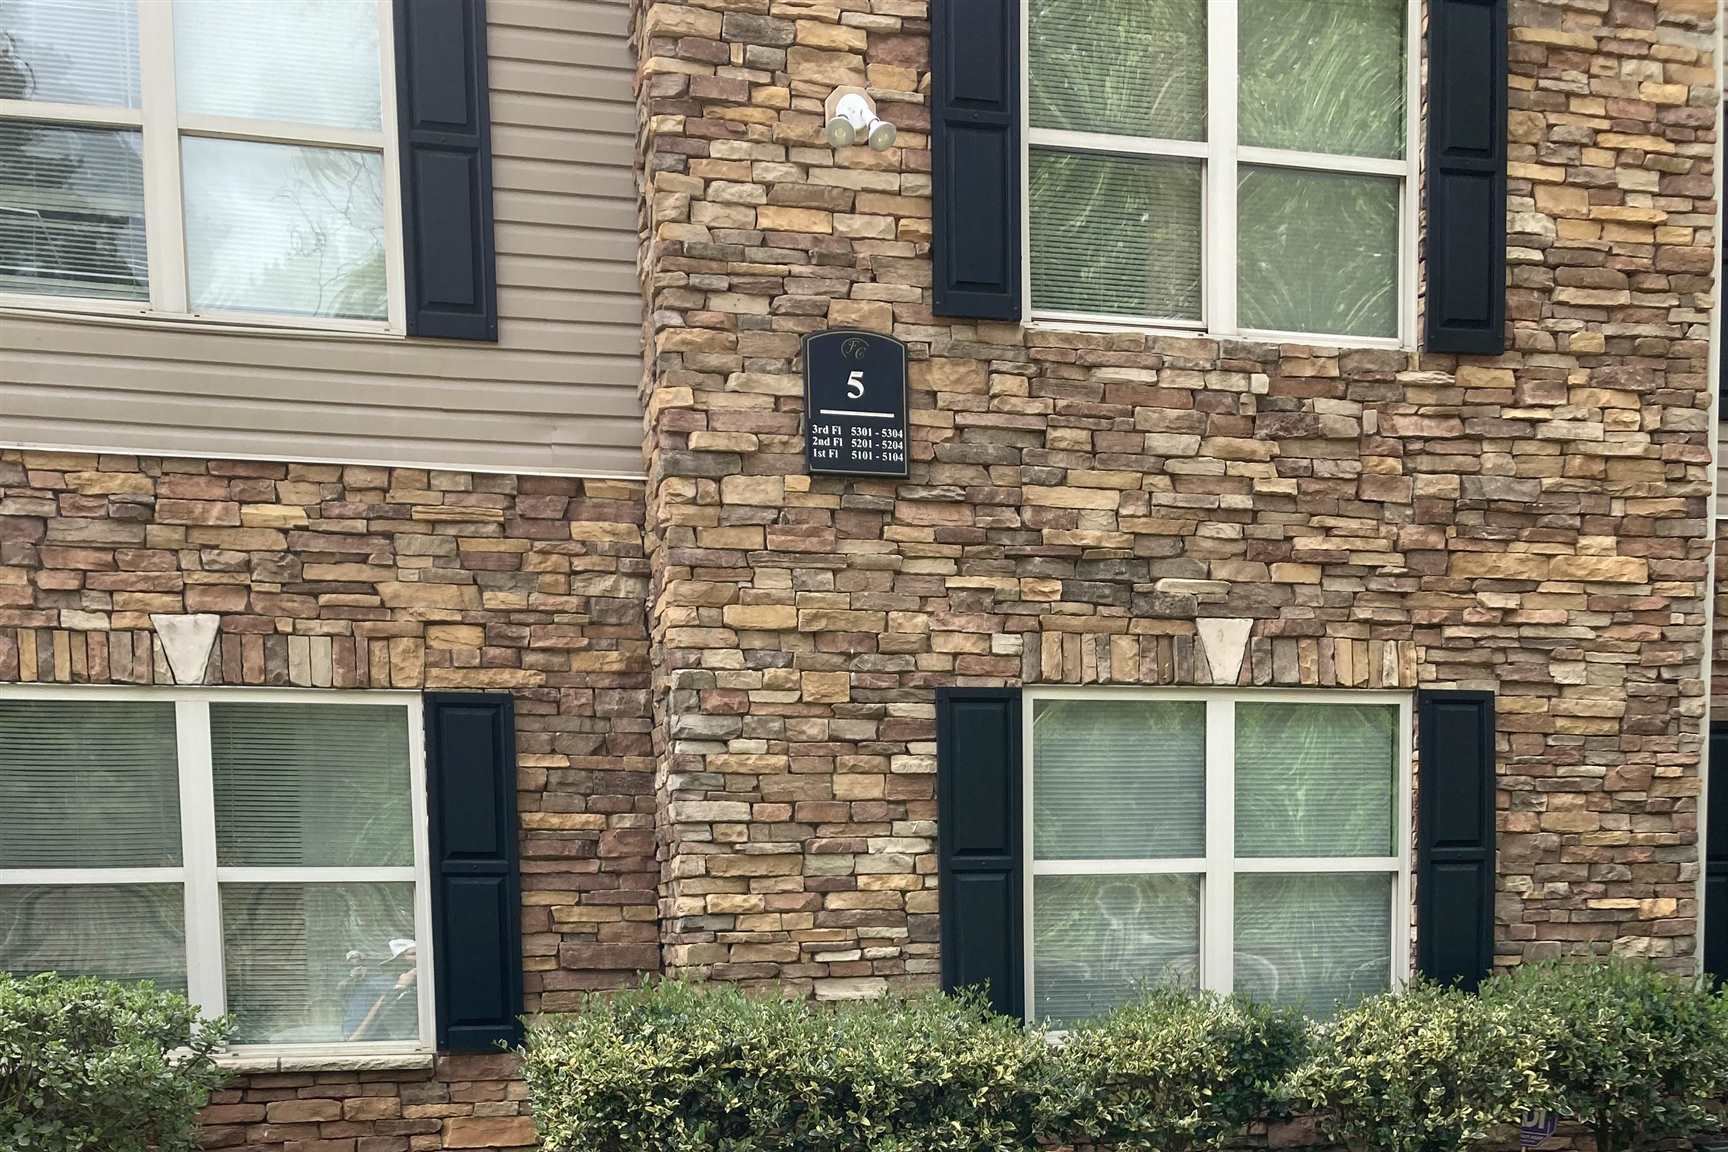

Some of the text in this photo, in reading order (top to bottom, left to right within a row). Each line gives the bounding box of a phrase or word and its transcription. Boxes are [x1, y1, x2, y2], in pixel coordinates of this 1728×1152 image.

[847, 371, 865, 399] 5
[812, 424, 828, 434] 3rd
[832, 426, 841, 435] Fl
[851, 427, 872, 436] 5301
[881, 428, 903, 438] 5304
[812, 436, 830, 446] 2nd
[833, 437, 843, 447] Fl
[851, 439, 872, 448] 5201
[881, 440, 903, 450] 5204
[813, 448, 826, 458] 1st
[829, 449, 838, 458] Fl
[851, 451, 872, 460] 5101
[882, 452, 903, 462] 5104
